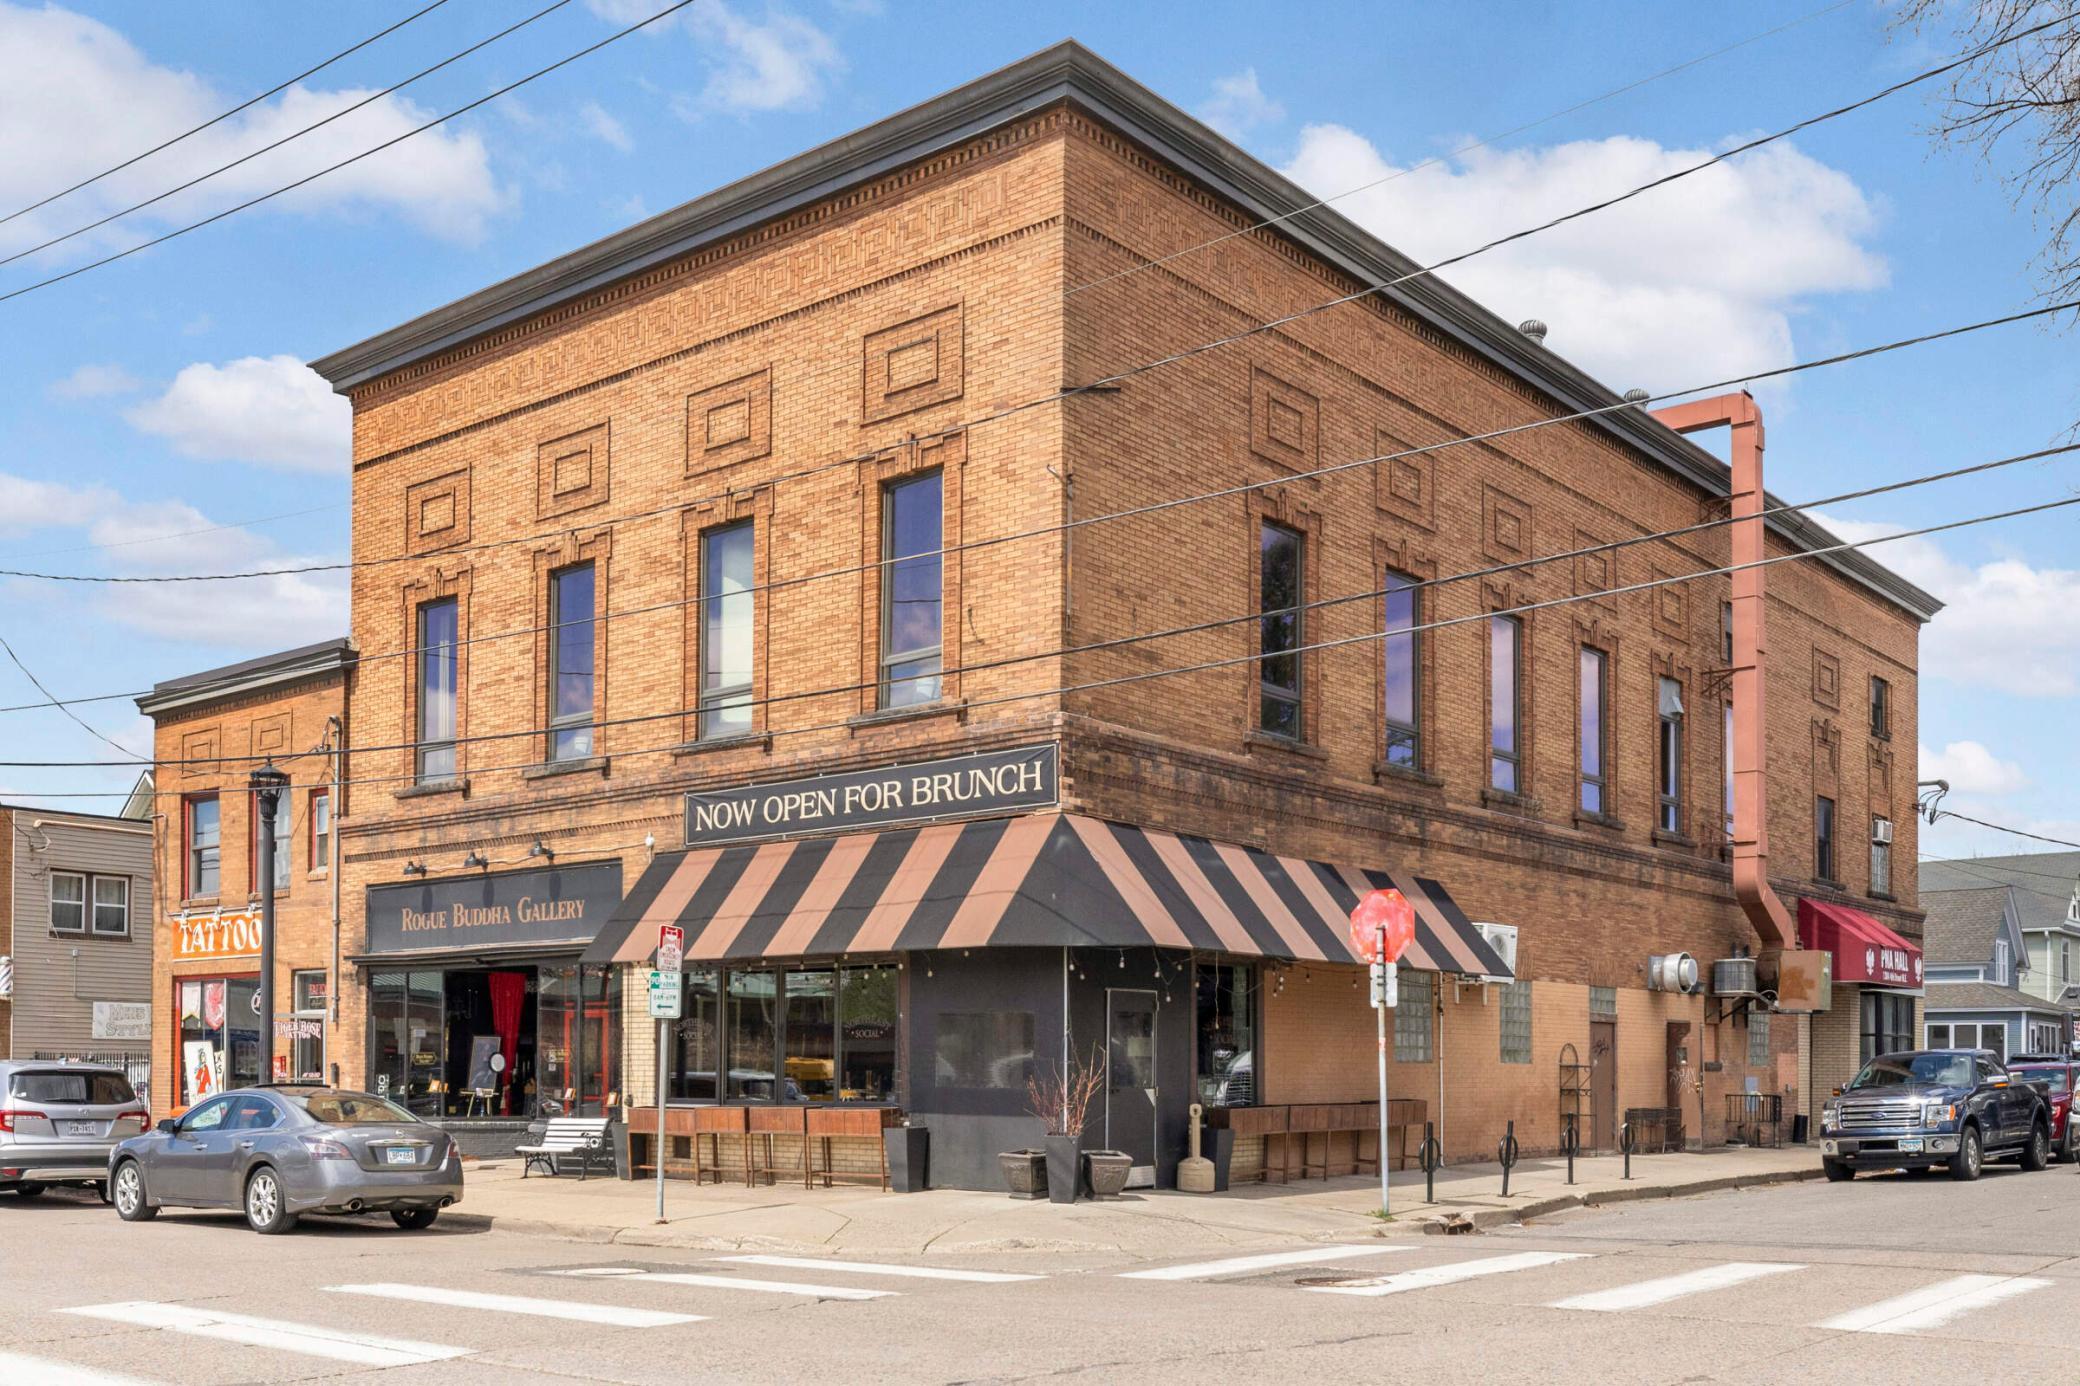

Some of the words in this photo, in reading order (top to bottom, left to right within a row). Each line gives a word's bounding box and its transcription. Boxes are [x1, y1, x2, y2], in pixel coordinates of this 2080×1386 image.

[695, 799, 755, 832] NOW
[763, 788, 837, 823] OPEN
[844, 781, 902, 814] FOR
[911, 761, 1043, 807] BRUNCH
[401, 907, 447, 931] ROGUE
[453, 903, 511, 928] BUDDHA
[517, 896, 585, 923] GALLERY
[179, 918, 262, 954] TATTOO
[1894, 950, 1909, 972] HALL
[300, 1021, 322, 1040] ROSE
